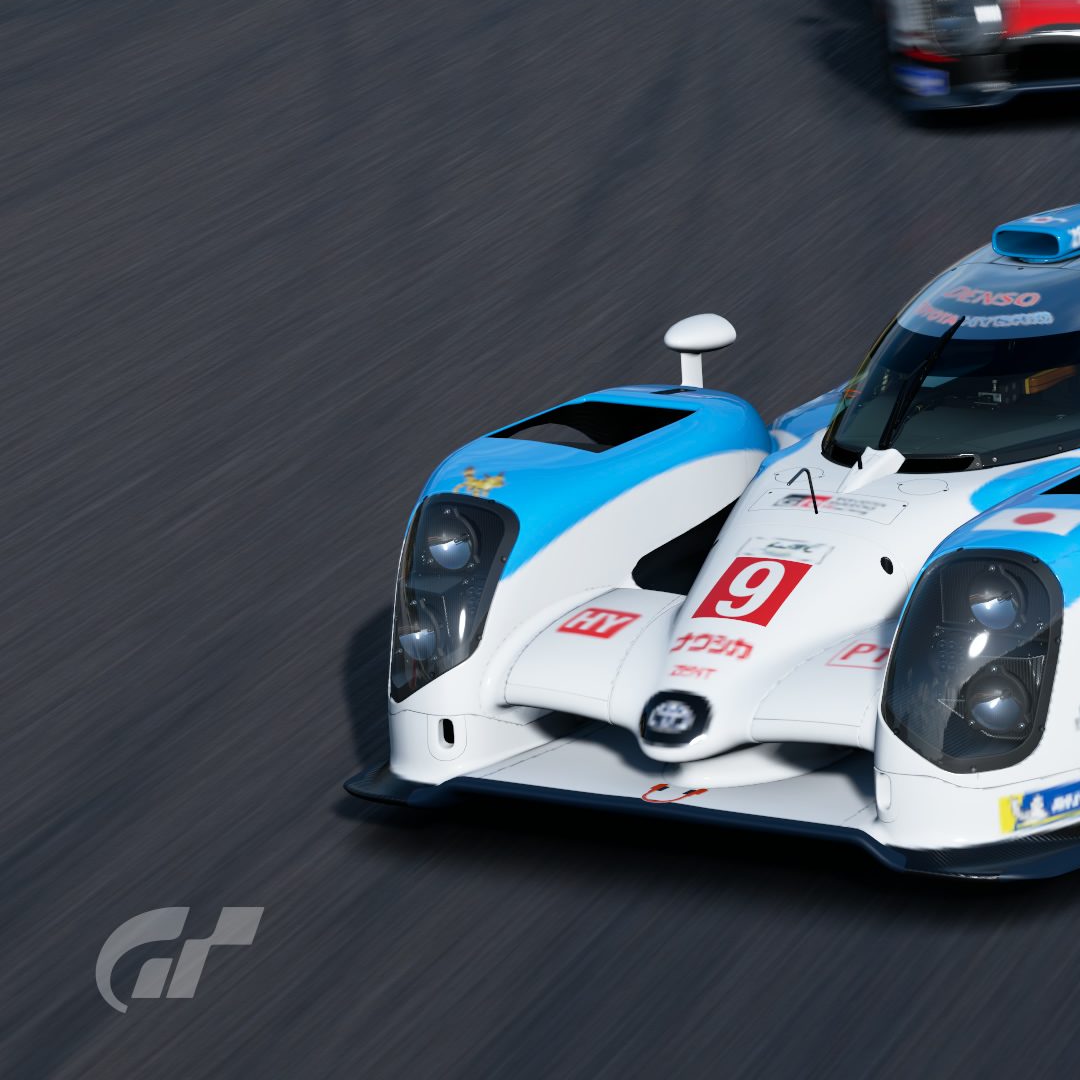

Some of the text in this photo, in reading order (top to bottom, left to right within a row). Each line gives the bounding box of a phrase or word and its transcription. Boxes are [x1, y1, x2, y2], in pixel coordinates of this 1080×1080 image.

[944, 285, 1042, 307] DENSO
[716, 561, 786, 618] 9
[563, 609, 634, 636] HY
[669, 632, 753, 661] ナウシカ
[840, 642, 890, 663] P1
